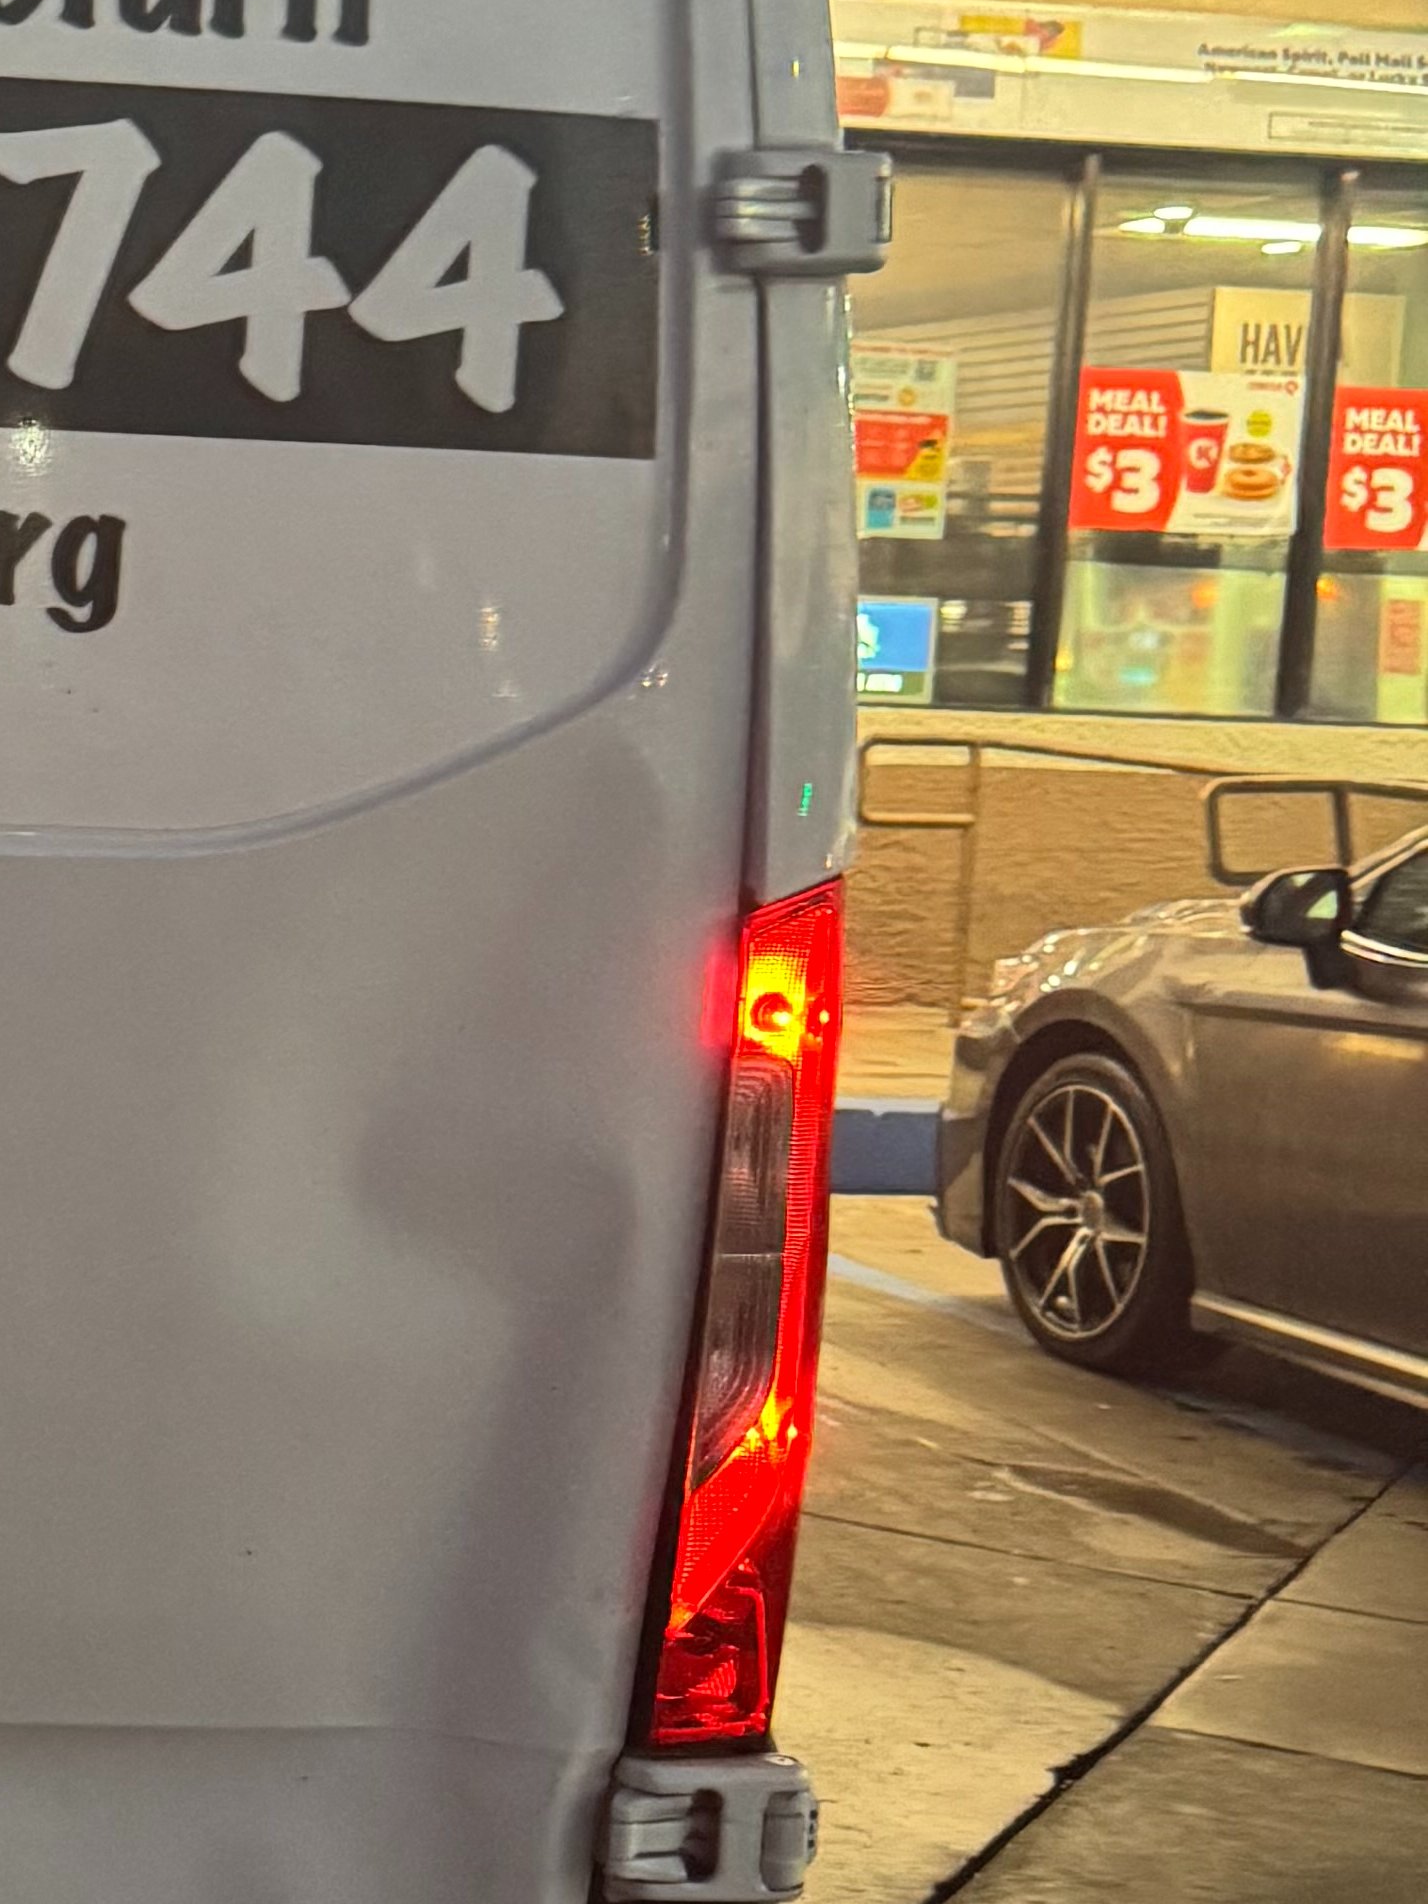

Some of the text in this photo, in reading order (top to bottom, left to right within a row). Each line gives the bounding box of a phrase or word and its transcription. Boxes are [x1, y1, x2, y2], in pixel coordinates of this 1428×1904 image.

[1240, 323, 1303, 367] HAV
[1088, 390, 1166, 414] MEAL
[1086, 414, 1168, 438] DEAL!
[1344, 408, 1421, 433] MEAL
[1342, 433, 1421, 457] DEAL!
[1084, 446, 1162, 514] $3
[1340, 465, 1414, 533] $3
